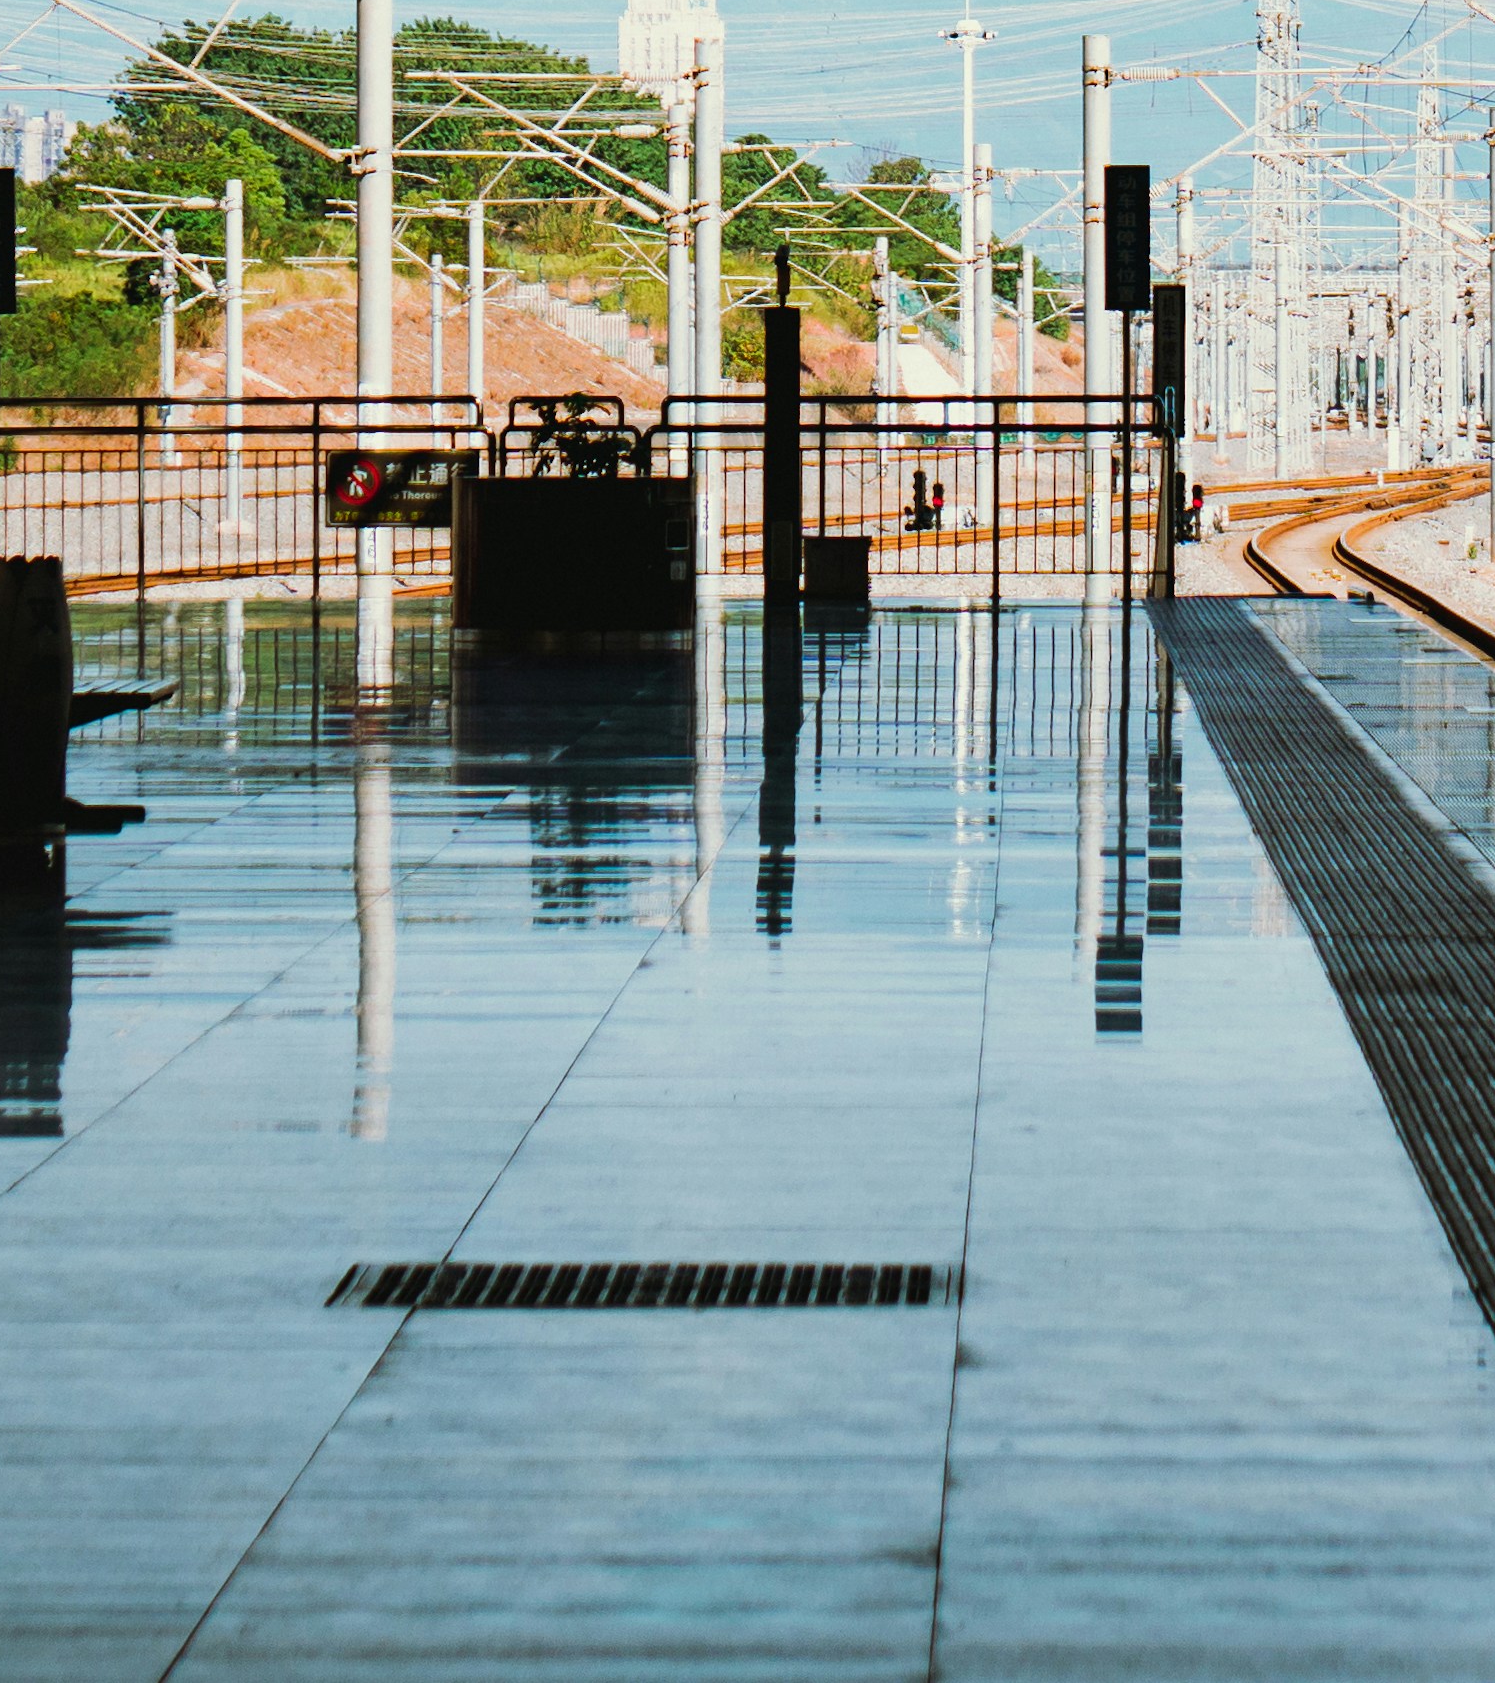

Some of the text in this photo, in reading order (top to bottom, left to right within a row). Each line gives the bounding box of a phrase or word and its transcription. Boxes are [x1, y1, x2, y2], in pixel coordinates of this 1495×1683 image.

[1116, 174, 1138, 303] 动车组停车位置
[1162, 295, 1177, 402] 机车停车
